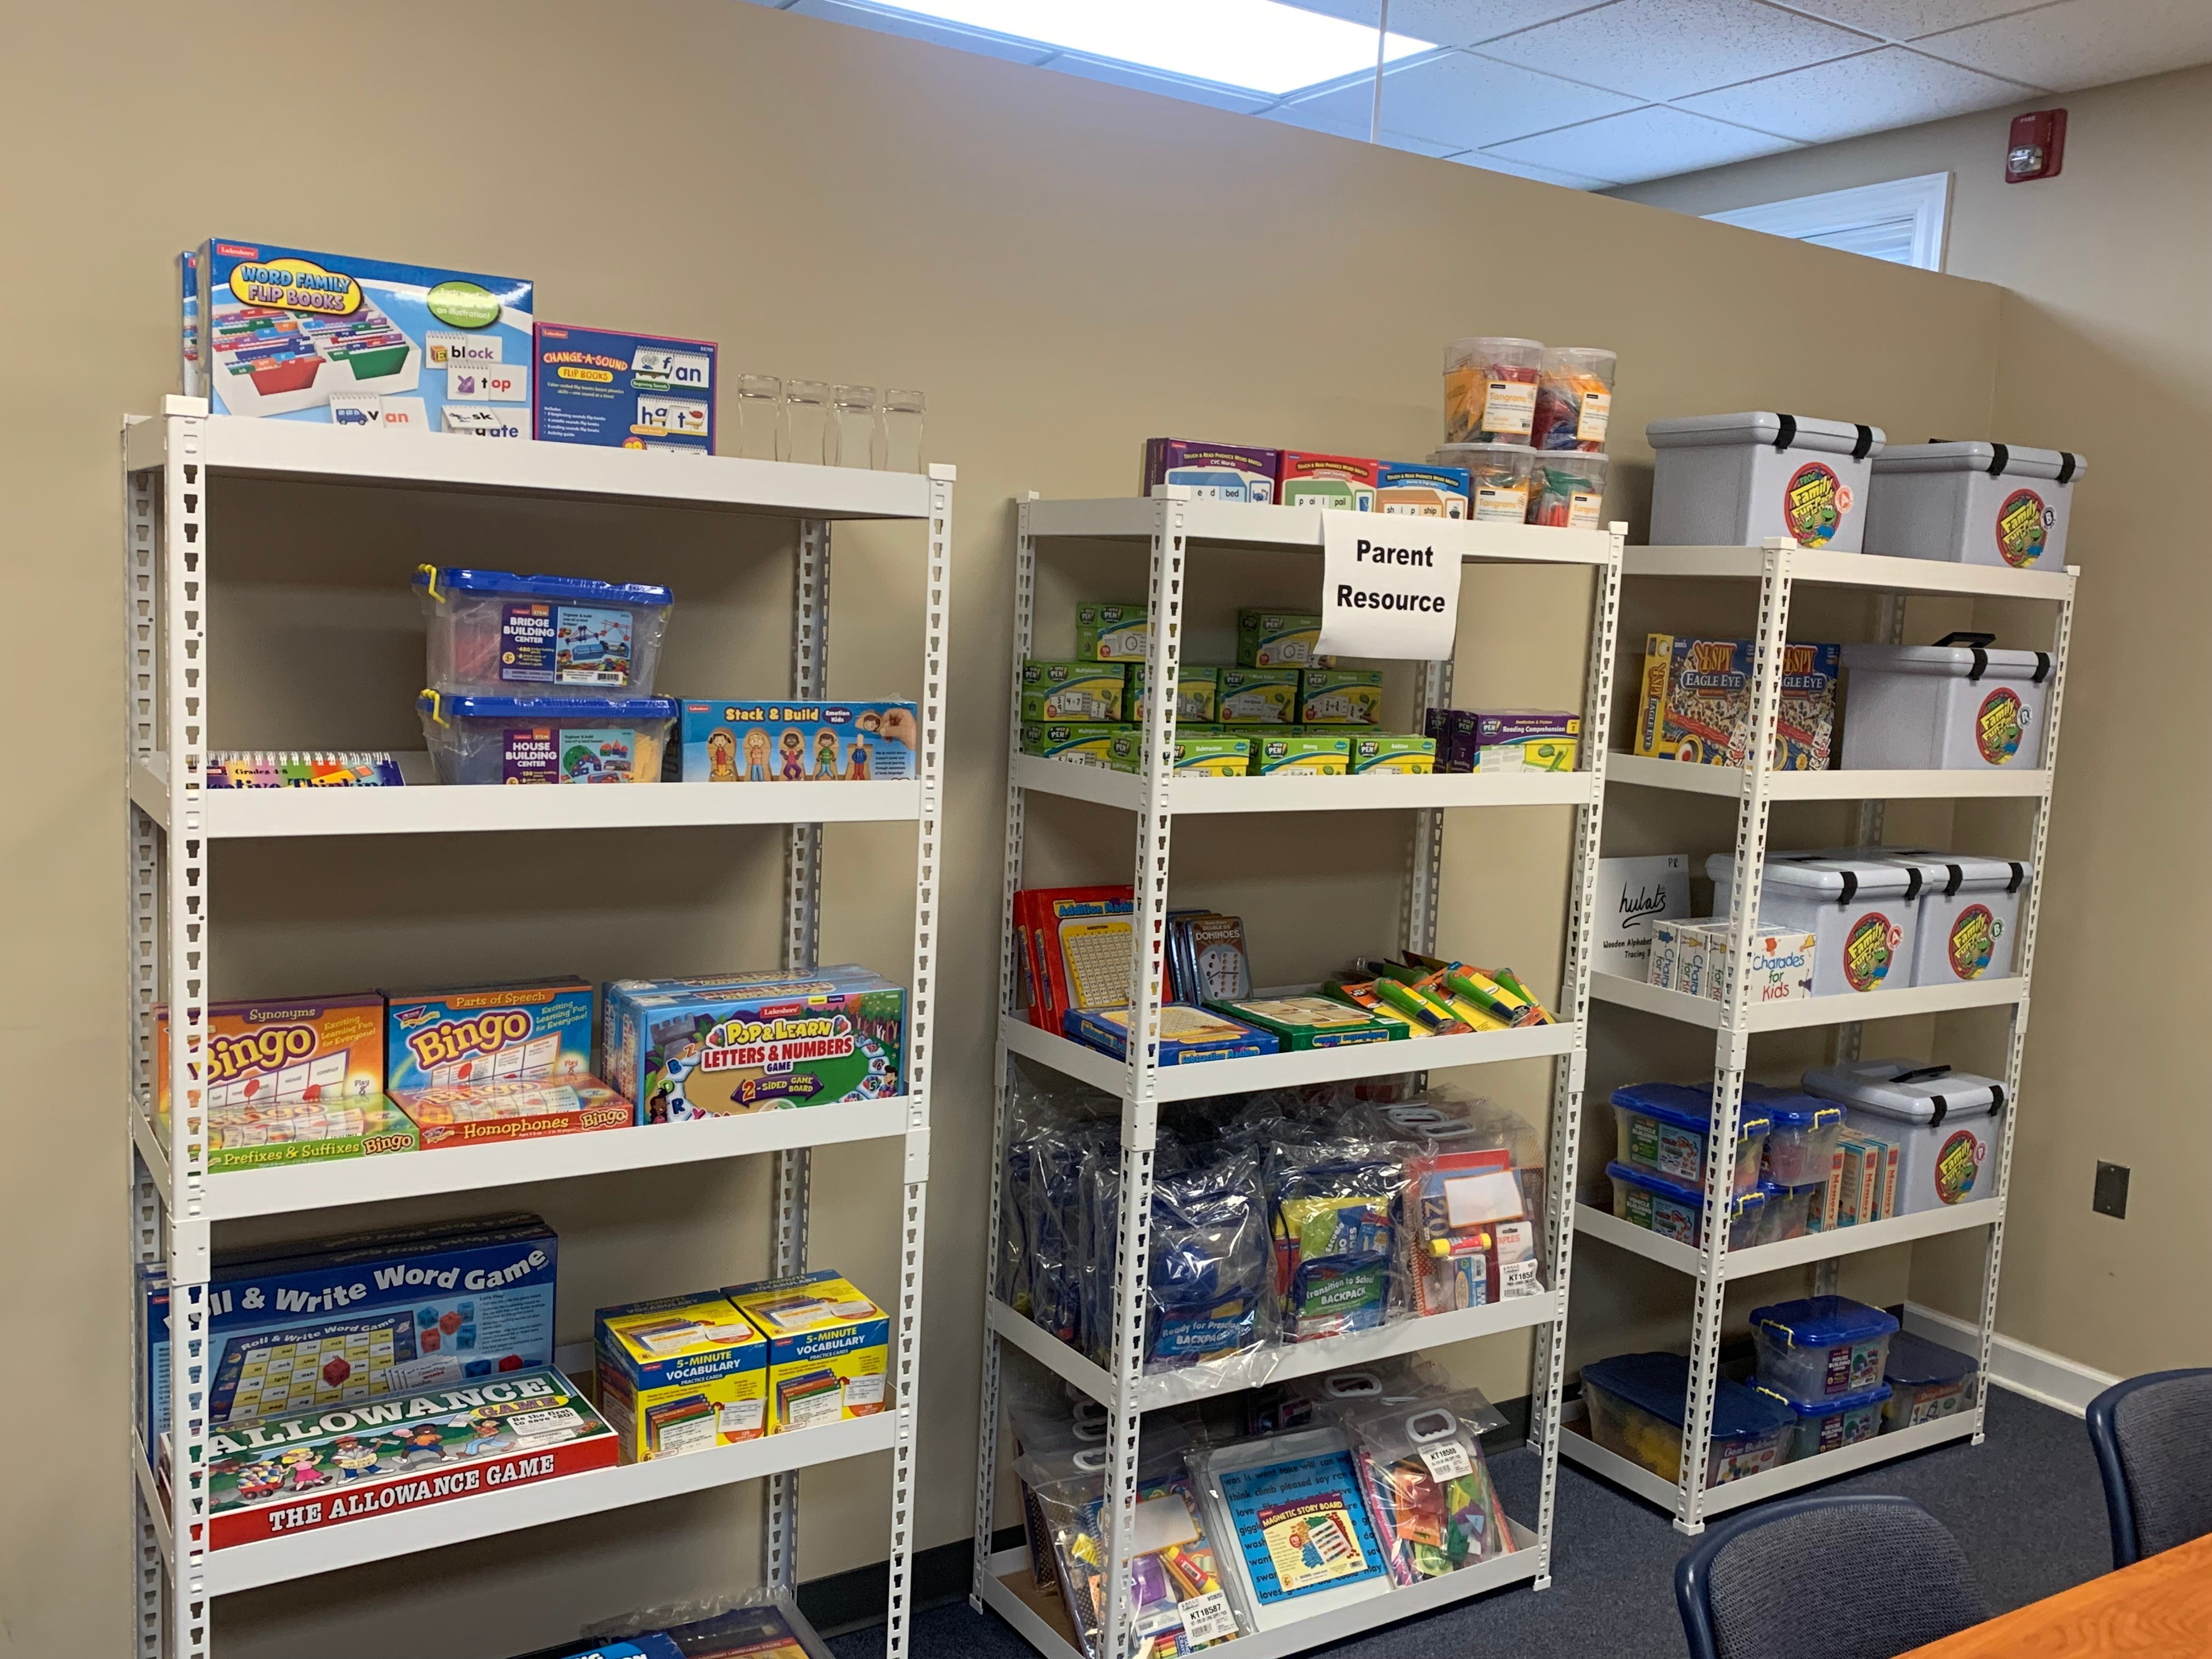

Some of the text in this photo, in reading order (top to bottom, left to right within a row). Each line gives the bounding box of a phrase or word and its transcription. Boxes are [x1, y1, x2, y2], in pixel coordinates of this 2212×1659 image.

[240, 266, 351, 293] WORD FAMILY
[249, 285, 345, 311] FLIP BOOKS
[452, 346, 494, 359] block
[543, 352, 628, 371] CHANGE-A-SOUND
[563, 369, 608, 381] FLIP BOOKS
[1489, 392, 1527, 403] Tangrams
[472, 412, 493, 420] sk
[1248, 458, 1262, 467] MATCH
[1790, 475, 1833, 506] Family
[1334, 497, 1346, 507] pail
[1479, 499, 1516, 509] Tangrams
[1424, 507, 1437, 515] ship
[2001, 500, 2038, 533] Family
[1357, 539, 1434, 567] Parent
[1337, 584, 1445, 613] Resource
[510, 617, 549, 627] BRIDGE
[503, 626, 555, 637] BUILDING
[1711, 647, 1734, 672] SPY
[1795, 649, 1815, 673] SPY
[1686, 673, 1741, 687] EAGLE EYE
[1804, 676, 1822, 689] EYE
[725, 707, 819, 723] Stack & Build
[826, 709, 850, 717] Emotion
[1980, 698, 2016, 730] Family
[512, 742, 550, 752] HOUSE
[505, 751, 557, 760] BUILDING
[1668, 858, 1678, 868] PR
[1058, 904, 1103, 916] Addition
[1196, 930, 1240, 941] DOMINOES
[1953, 914, 1987, 948] Family
[1603, 940, 1625, 949] Wooden
[1848, 923, 1884, 959] Family
[1624, 950, 1645, 959] Tracing
[1753, 953, 1804, 971] Charades
[1769, 970, 1784, 983] for
[456, 992, 546, 1008] Parts of Speech
[1762, 983, 1789, 1001] Kids
[250, 1008, 316, 1021] Synonyms
[536, 1005, 588, 1024] Learning Fun
[541, 1001, 574, 1015] Exciting
[764, 1006, 800, 1016] Lakeshore
[324, 1015, 360, 1030] Exciting
[547, 1011, 588, 1030] Everyone!
[321, 1022, 374, 1039] Learning Fun
[322, 1028, 376, 1047] for Everyone!
[413, 1014, 527, 1066] Bingo
[704, 1037, 852, 1068] LETTERS & NUMBERS
[1182, 1049, 1259, 1064] Subtraction Machine
[668, 1059, 682, 1075] B
[767, 1062, 791, 1072] GAME
[355, 1080, 370, 1088] Play
[358, 1086, 366, 1095] 8
[788, 1084, 814, 1092] BOARD
[672, 1098, 685, 1115] R
[464, 1116, 568, 1139] Homophones
[580, 1109, 628, 1129] Bingo
[224, 1133, 413, 1166] Prefixes & Suffixes Bingo
[1325, 1222, 1345, 1253] Escuela
[242, 1250, 546, 1313] & Write Word Game
[1307, 1277, 1354, 1300] Transition to
[1321, 1287, 1366, 1305] BACKPACK
[241, 1336, 268, 1351] Roll
[285, 1331, 321, 1342] Write
[324, 1325, 360, 1334] Word
[361, 1318, 396, 1331] Game
[806, 1327, 857, 1344] 5-MINUTE
[1163, 1321, 1207, 1337] Ready for
[797, 1335, 866, 1355] VOCABULARY
[676, 1351, 732, 1368] 5-MINUTE
[810, 1351, 832, 1361] PRACTICE
[665, 1359, 741, 1381] VOCABULARY
[680, 1377, 705, 1385] PRACTICE
[478, 1397, 559, 1417] GAME
[209, 1378, 555, 1456] ALLOWANCE
[1724, 1439, 1778, 1457] Gear Building
[1279, 1458, 1334, 1474] take will can
[269, 1454, 555, 1532] THE ALLOWANCE GAME
[1229, 1475, 1330, 1503] think pleased say
[1235, 1508, 1255, 1517] love
[1262, 1501, 1342, 1527] MAGNETIC STORY BOARD
[1249, 1555, 1272, 1566] want
[1259, 1587, 1283, 1600] loves
[1190, 1604, 1222, 1620] KT18587
